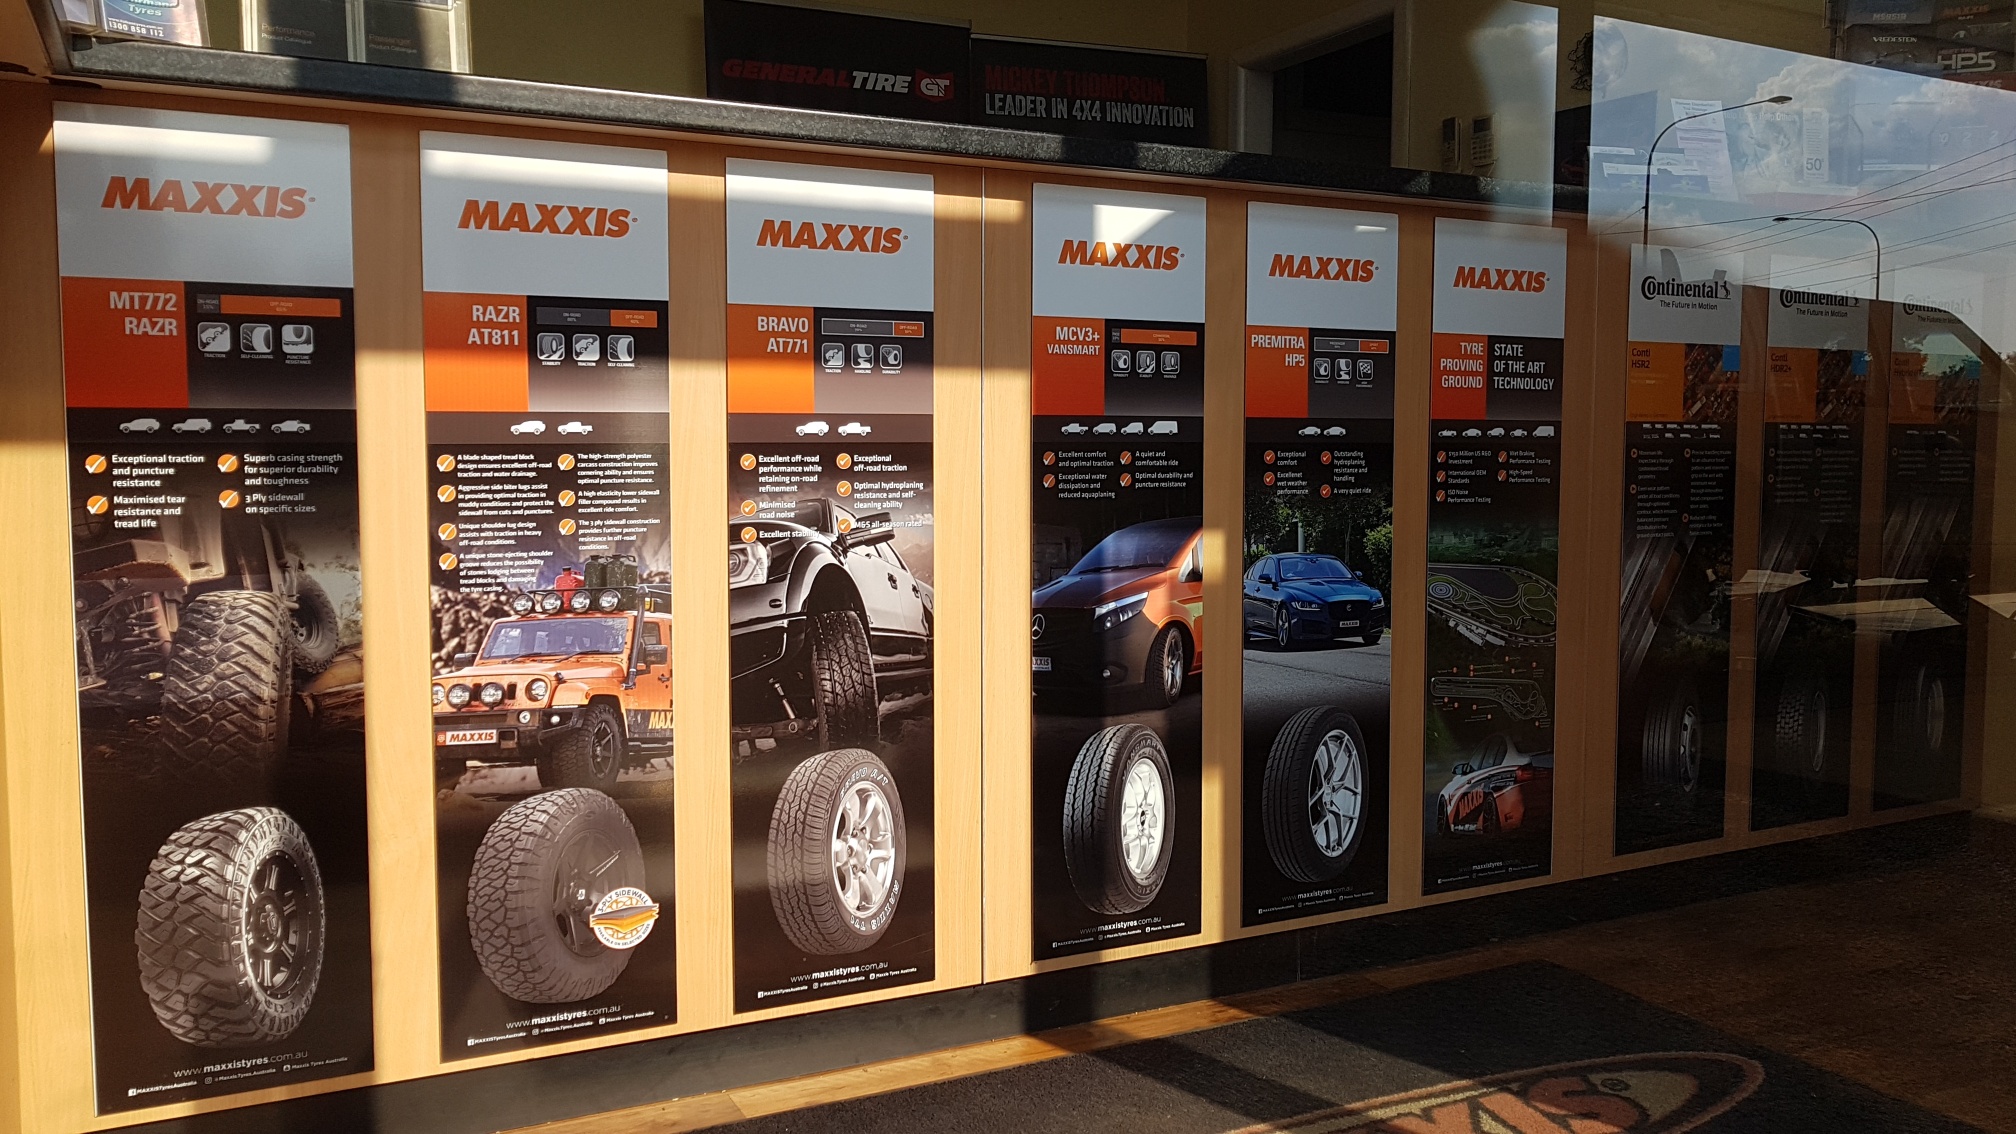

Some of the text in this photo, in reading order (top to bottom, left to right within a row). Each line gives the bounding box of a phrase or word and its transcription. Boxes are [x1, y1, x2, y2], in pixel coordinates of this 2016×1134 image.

[128, 4, 162, 16] Tyres
[109, 21, 128, 31] 1300
[150, 28, 164, 37] 112
[262, 23, 315, 37] Performance
[1938, 51, 1996, 73] HP5
[722, 59, 850, 87] GENERAL
[853, 71, 912, 93] TIRE
[985, 65, 1165, 102] MICKEY THOMPSON
[985, 93, 1194, 128] LEADER IN 4X4 INNOVATION
[101, 176, 307, 219] MAXXIS
[457, 199, 630, 238] MAXXIS
[757, 219, 902, 254] MAXXIS
[1058, 239, 1180, 271] MAXXIS
[1269, 254, 1374, 283] MAXXIS
[1453, 266, 1546, 293] MAXXIS
[1641, 276, 1718, 300] Continental
[109, 291, 177, 311] MT772
[1780, 285, 1849, 308] Continental
[1660, 300, 1670, 308] The
[1698, 302, 1718, 310] Motion
[472, 305, 520, 323] RAZR
[1831, 310, 1848, 318] Motion
[125, 317, 178, 336] RAZR
[758, 316, 809, 333] BRAVO
[467, 328, 520, 346] AT811
[1056, 327, 1100, 341] MCV3+
[767, 338, 808, 353] AT771
[1252, 335, 1305, 349] PREMITRA
[1047, 344, 1100, 355] VANSMART
[1460, 342, 1484, 355] TYRE
[1494, 344, 1523, 356] STATE
[1632, 348, 1650, 358] Conti
[1285, 354, 1305, 366] HP5
[1771, 353, 1788, 362] Conti
[1440, 359, 1483, 371] PROVING
[1494, 361, 1545, 374] OF THE ART
[1632, 360, 1650, 368] HSR2
[1770, 365, 1792, 373] HDR2+
[1442, 376, 1482, 388] GROUND
[1494, 377, 1554, 390] TECHNOLOGY
[112, 455, 166, 464] Exceptional
[244, 454, 343, 463] Superb casing strength
[854, 455, 891, 463] Exceptional
[1070, 460, 1092, 468] optimal
[113, 467, 174, 476] and puncture
[260, 465, 295, 474] superior
[297, 465, 338, 474] durability
[759, 465, 802, 474] performance
[113, 479, 161, 487] resistance
[245, 477, 309, 486] and toughness
[759, 475, 789, 483] retaining
[854, 482, 923, 490] Optimal hydroplaning
[113, 496, 165, 504] Maximised
[245, 493, 304, 503] 3 Ply sidewall
[1082, 491, 1115, 499] aquaplaning
[259, 505, 292, 514] specific
[883, 501, 902, 509] ability
[114, 507, 181, 516] resistance and
[114, 519, 157, 528] tread life
[449, 731, 494, 742] MAXXIS
[1282, 886, 1354, 902] www.maxxistyres.com.au
[598, 890, 648, 912] 3-PLY SIDEWALL
[1080, 916, 1161, 935] www.maxxistyres.com.au
[791, 961, 888, 983] www.maxxistyres.com.au
[506, 1004, 621, 1030] www.maxxistyres.com.au
[173, 1050, 309, 1078] www.maxxistyres.com.au
